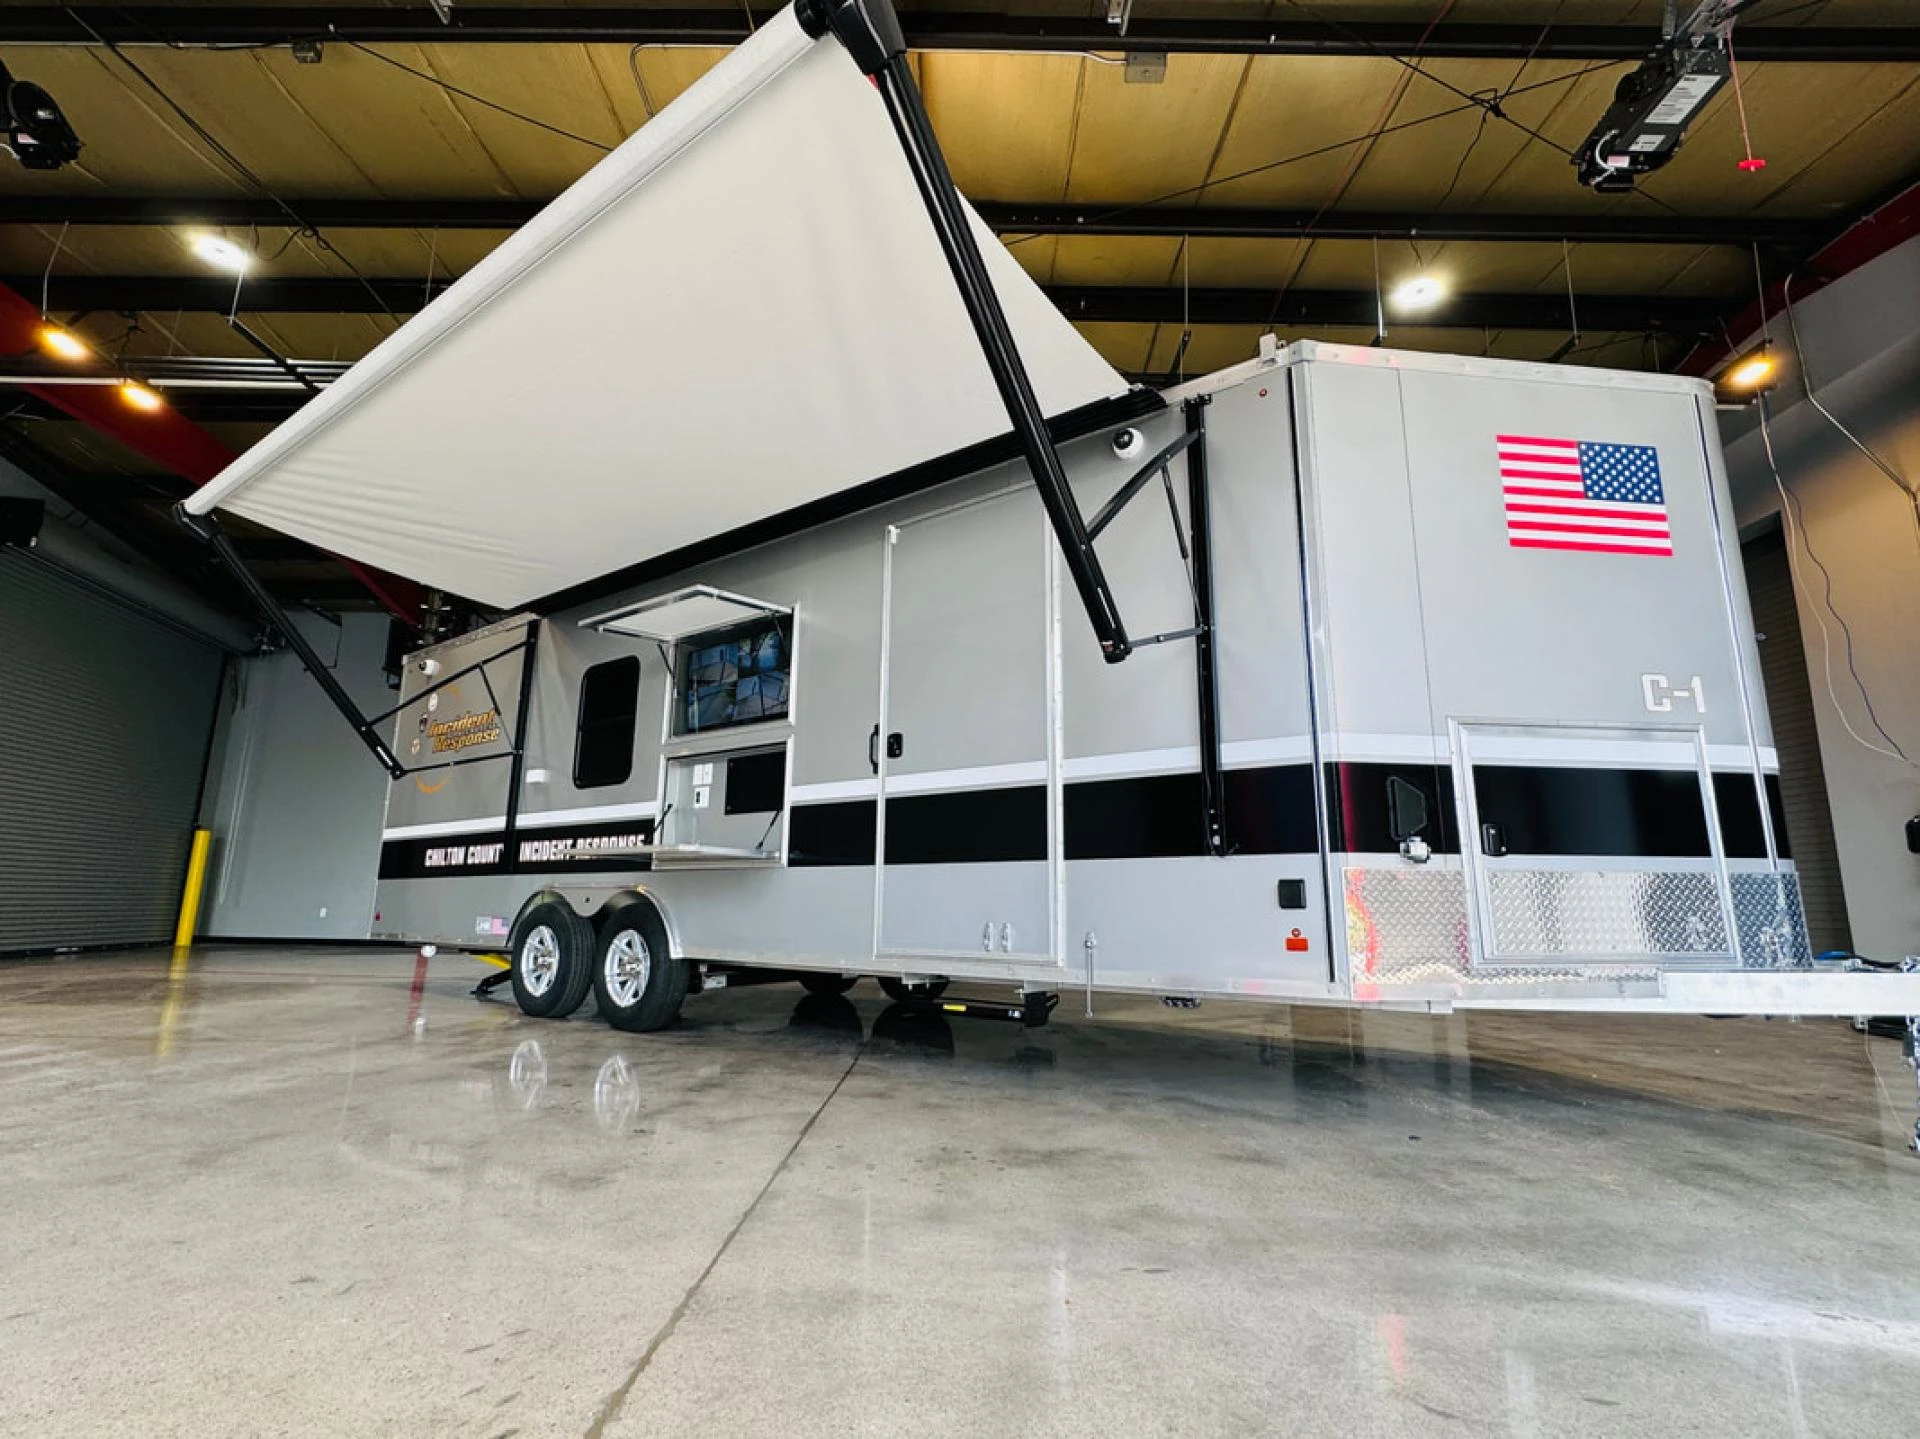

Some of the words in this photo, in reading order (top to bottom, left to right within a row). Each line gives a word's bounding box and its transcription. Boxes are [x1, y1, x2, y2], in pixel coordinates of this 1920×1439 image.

[1642, 674, 1706, 712] C-1
[428, 708, 495, 737] Incident
[432, 728, 500, 753] Response
[426, 846, 466, 867] CHILTON
[467, 843, 505, 865] COUNT
